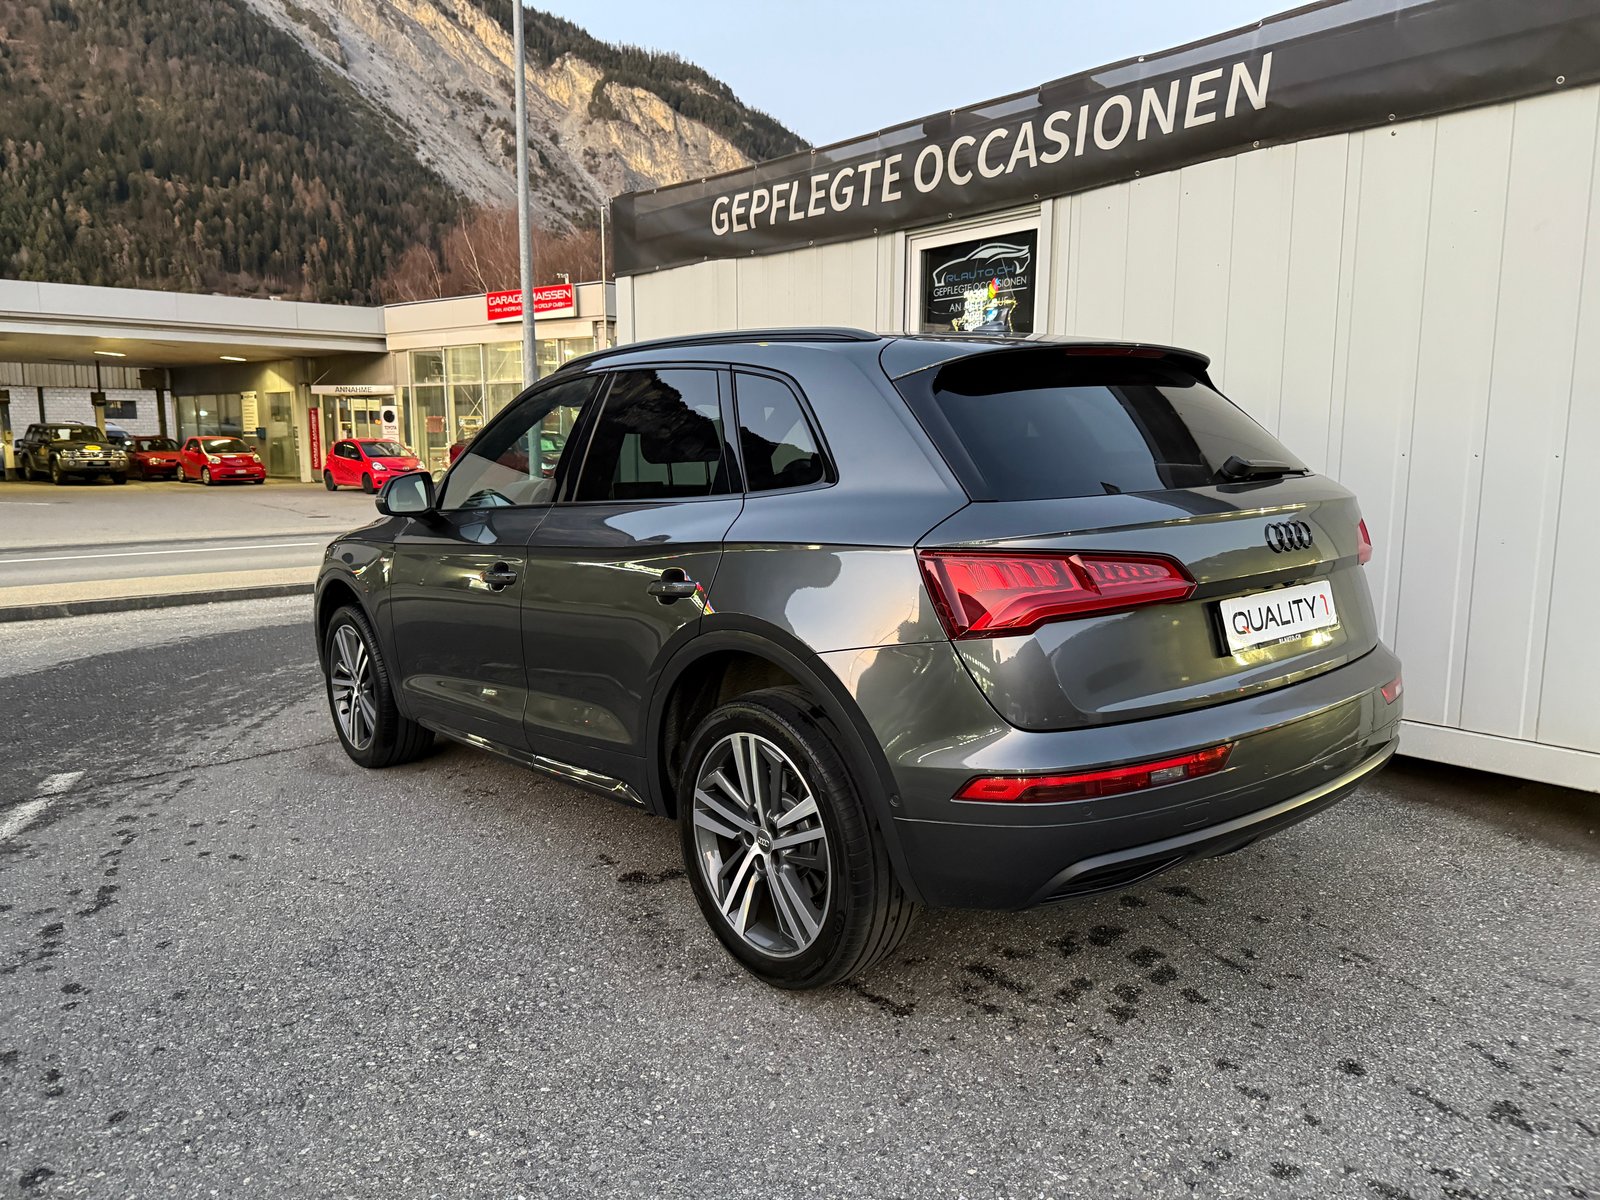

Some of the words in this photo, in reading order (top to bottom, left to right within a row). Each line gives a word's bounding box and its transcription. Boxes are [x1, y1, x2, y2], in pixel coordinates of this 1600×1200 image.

[710, 152, 903, 237] GEPFLEGTE
[913, 51, 1274, 193] OCCASIONEN
[945, 265, 1015, 282] RLAUTO.CH
[933, 283, 972, 297] GEPFLEGTE
[1232, 595, 1316, 635] QUALITY
[1319, 594, 1329, 616] 1
